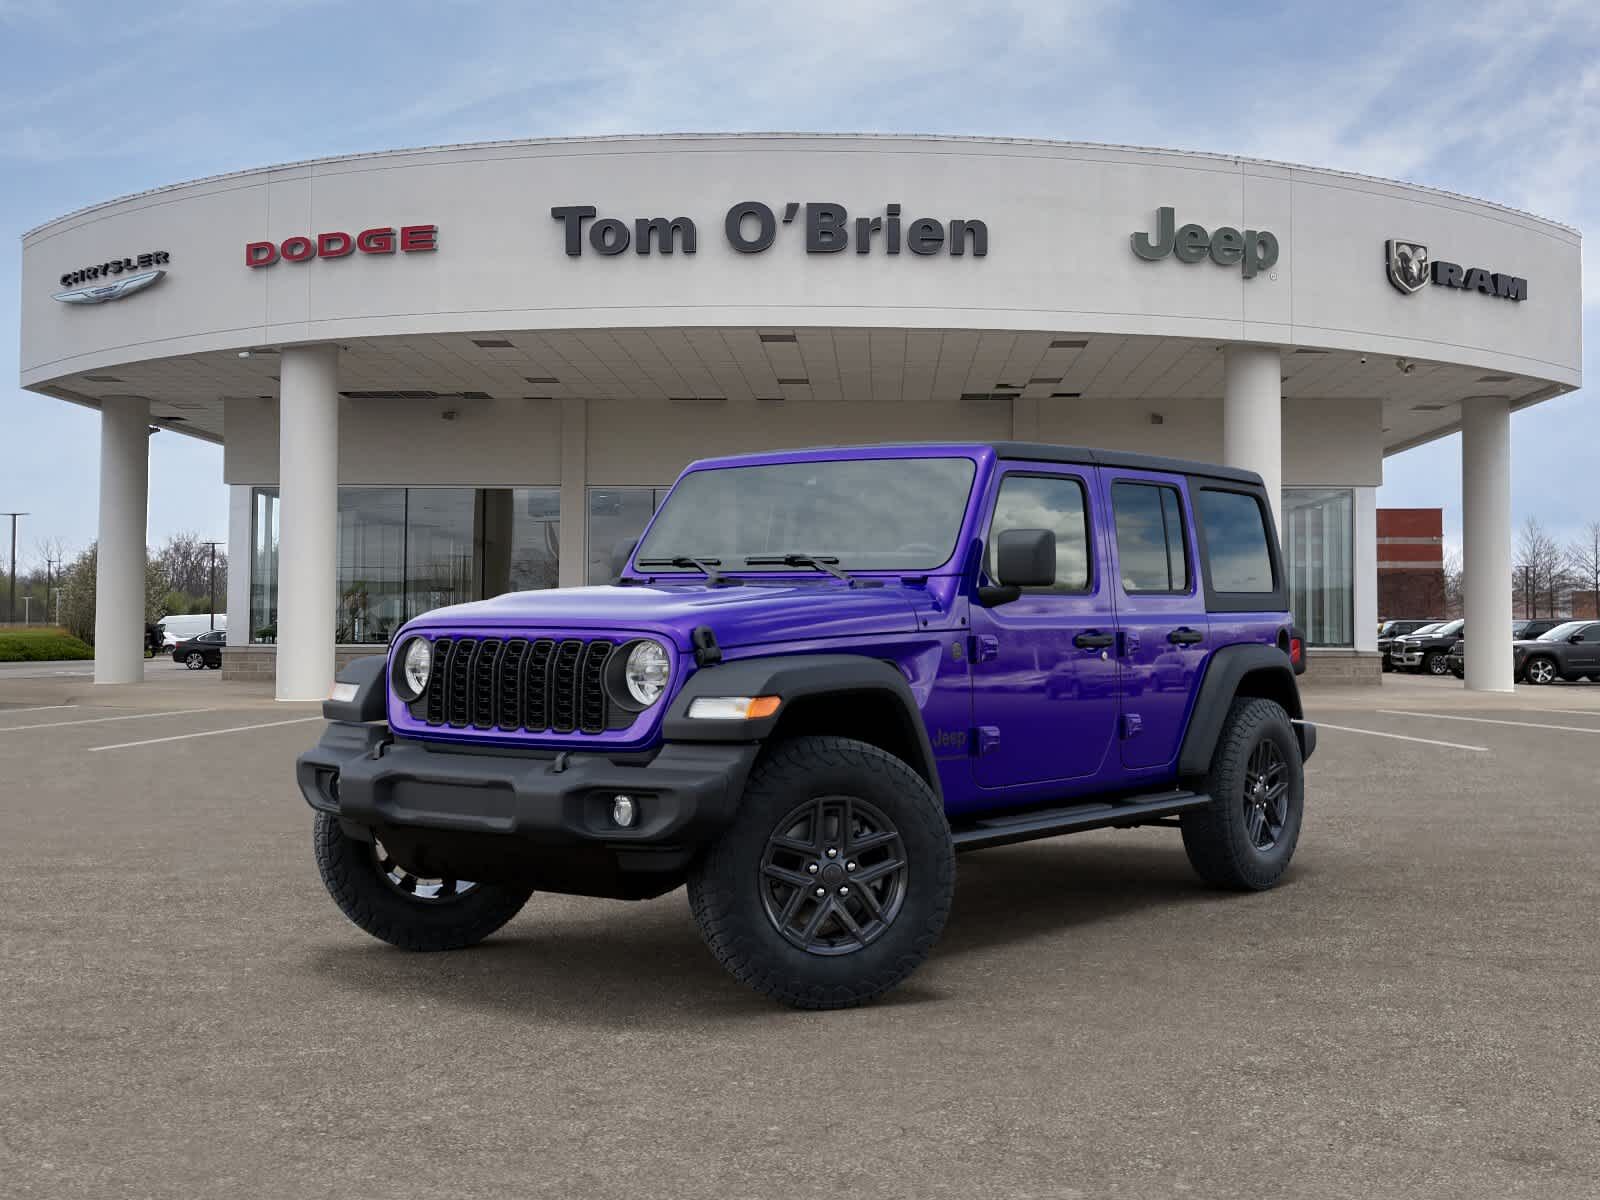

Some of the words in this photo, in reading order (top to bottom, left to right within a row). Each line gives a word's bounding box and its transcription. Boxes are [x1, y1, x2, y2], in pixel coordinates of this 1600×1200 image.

[245, 224, 438, 269] DODGE
[551, 205, 697, 257] Tom
[725, 200, 988, 257] O'Brien
[1130, 206, 1279, 279] Jeep
[60, 249, 170, 287] CHRYSLER
[1431, 260, 1528, 302] RAM
[933, 728, 966, 748] Jeep
